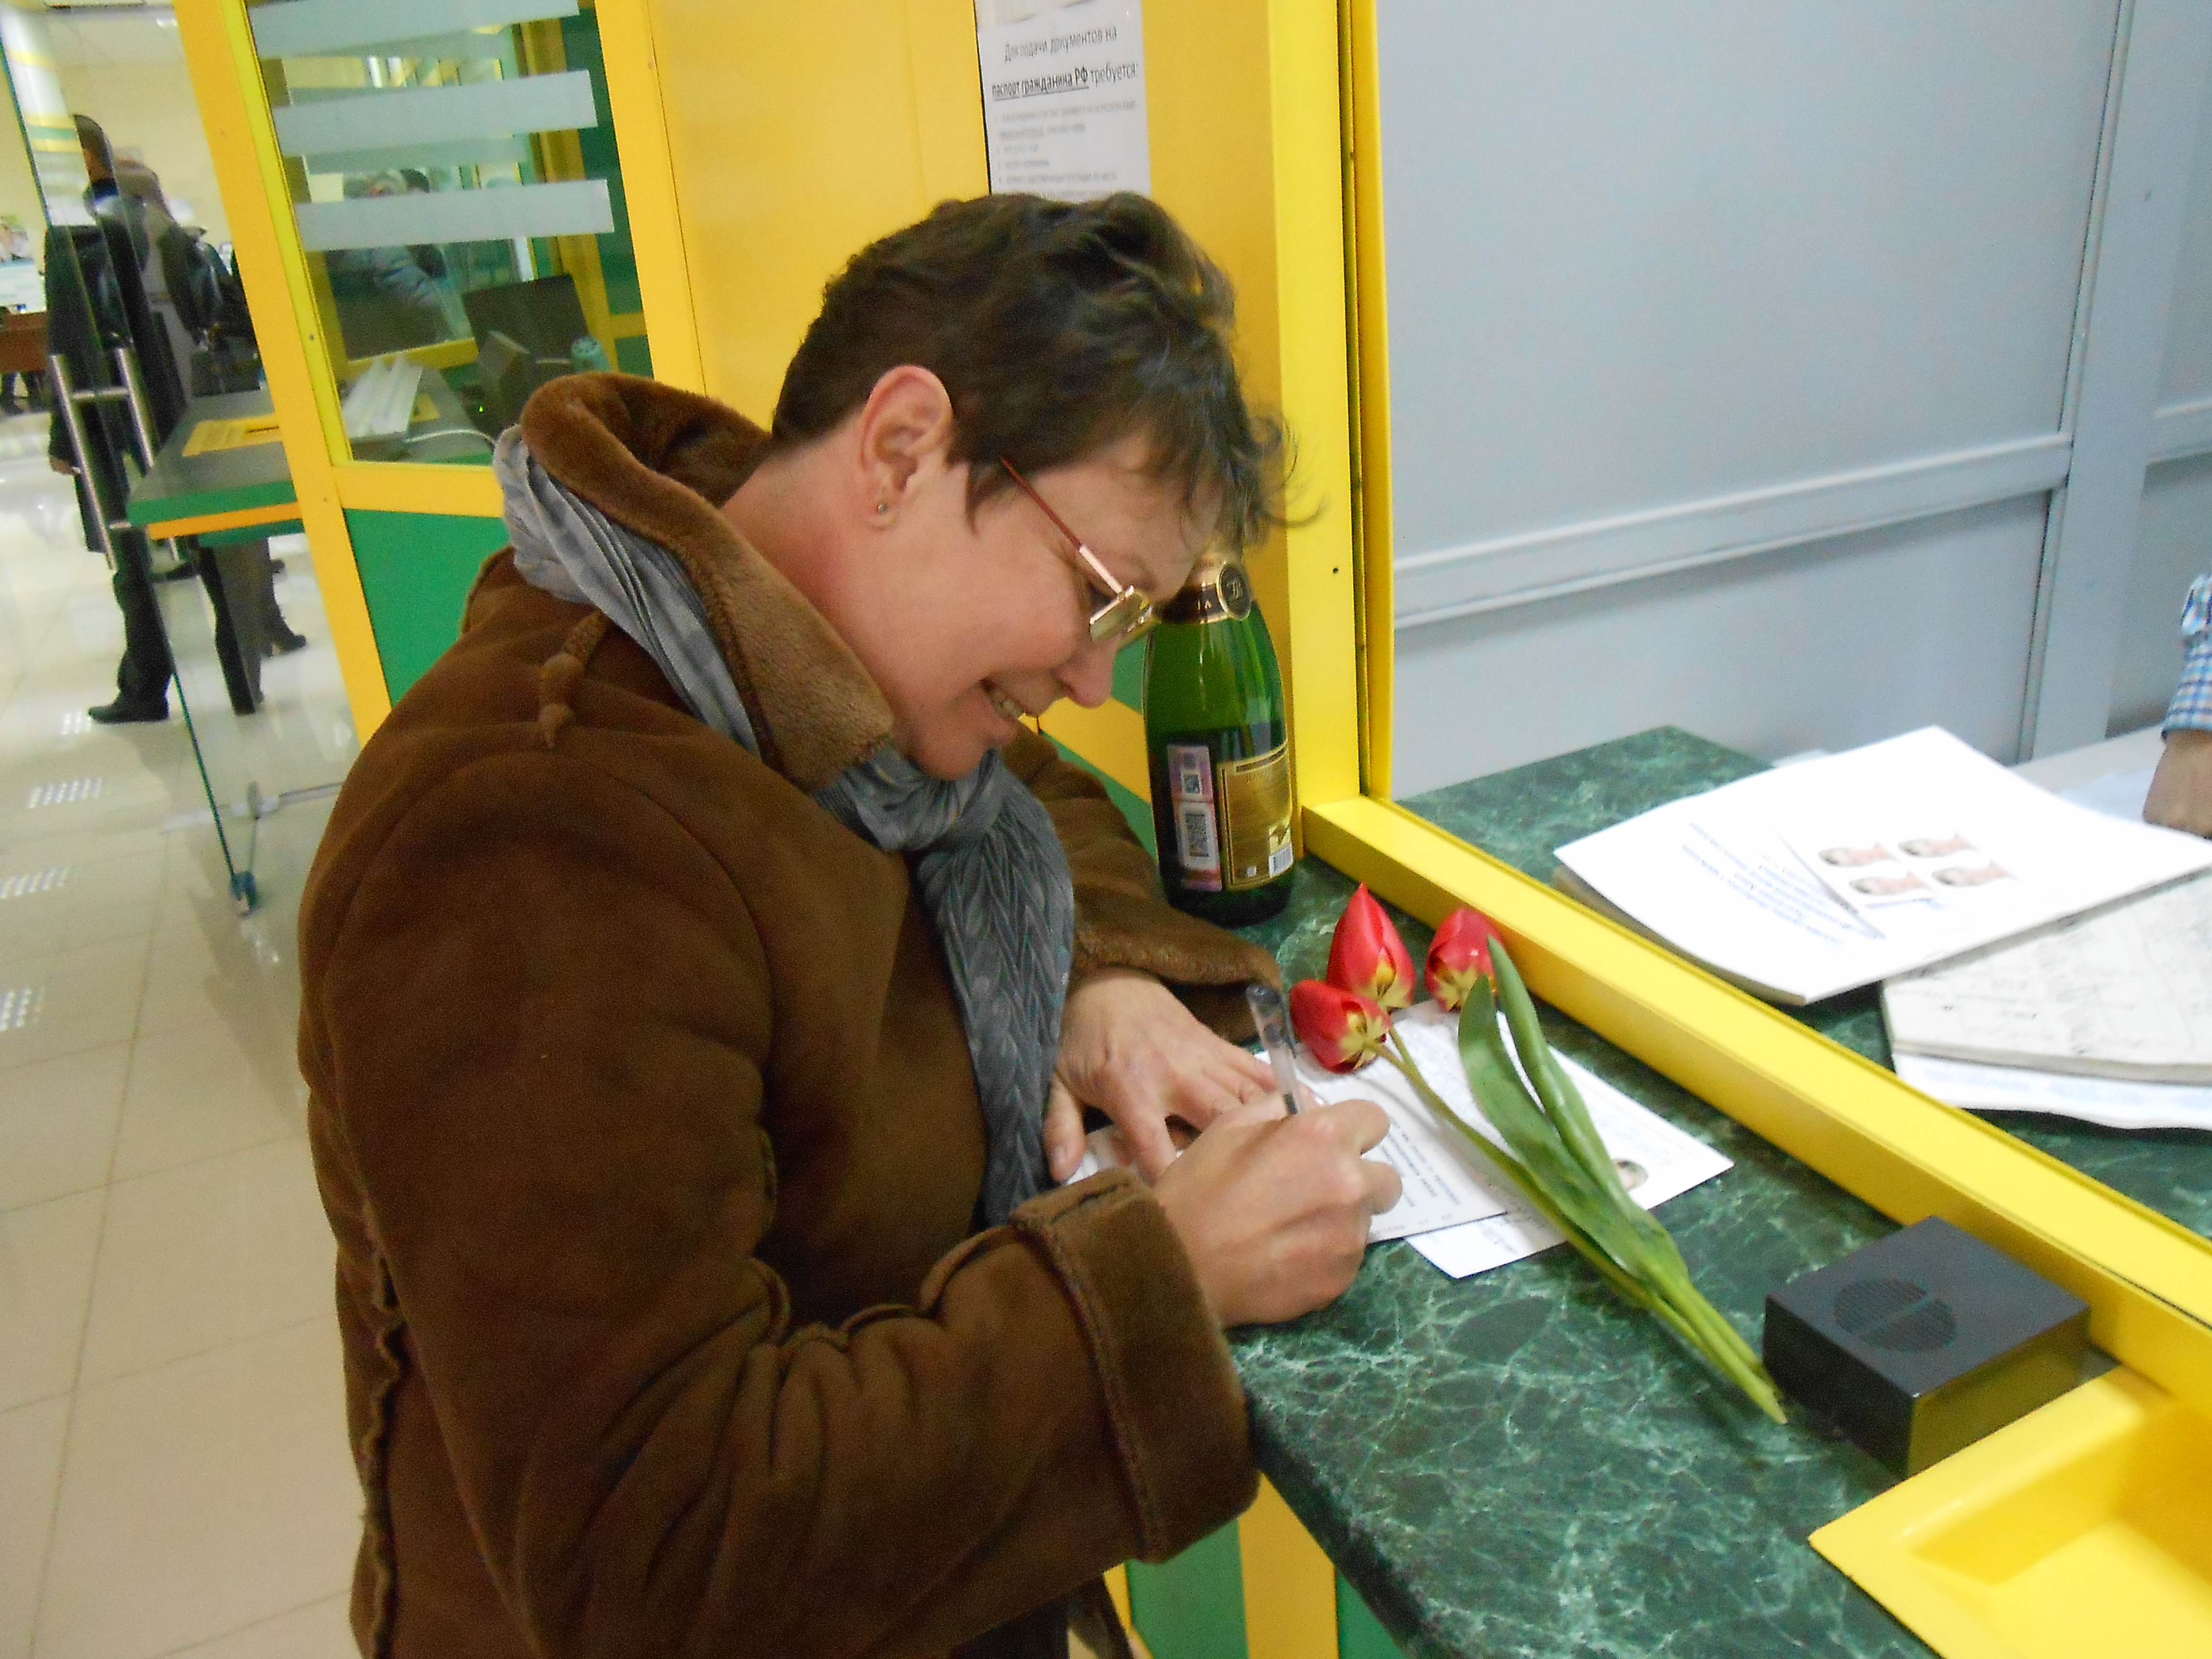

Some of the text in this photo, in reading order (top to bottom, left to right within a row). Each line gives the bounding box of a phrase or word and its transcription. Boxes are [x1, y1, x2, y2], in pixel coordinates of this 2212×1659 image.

[1020, 39, 1047, 57] подачи
[1051, 29, 1103, 54] документов
[1106, 26, 1118, 41] на
[992, 81, 1020, 97] паспорт
[1022, 73, 1073, 95] гражданина
[1075, 66, 1088, 85] РФ
